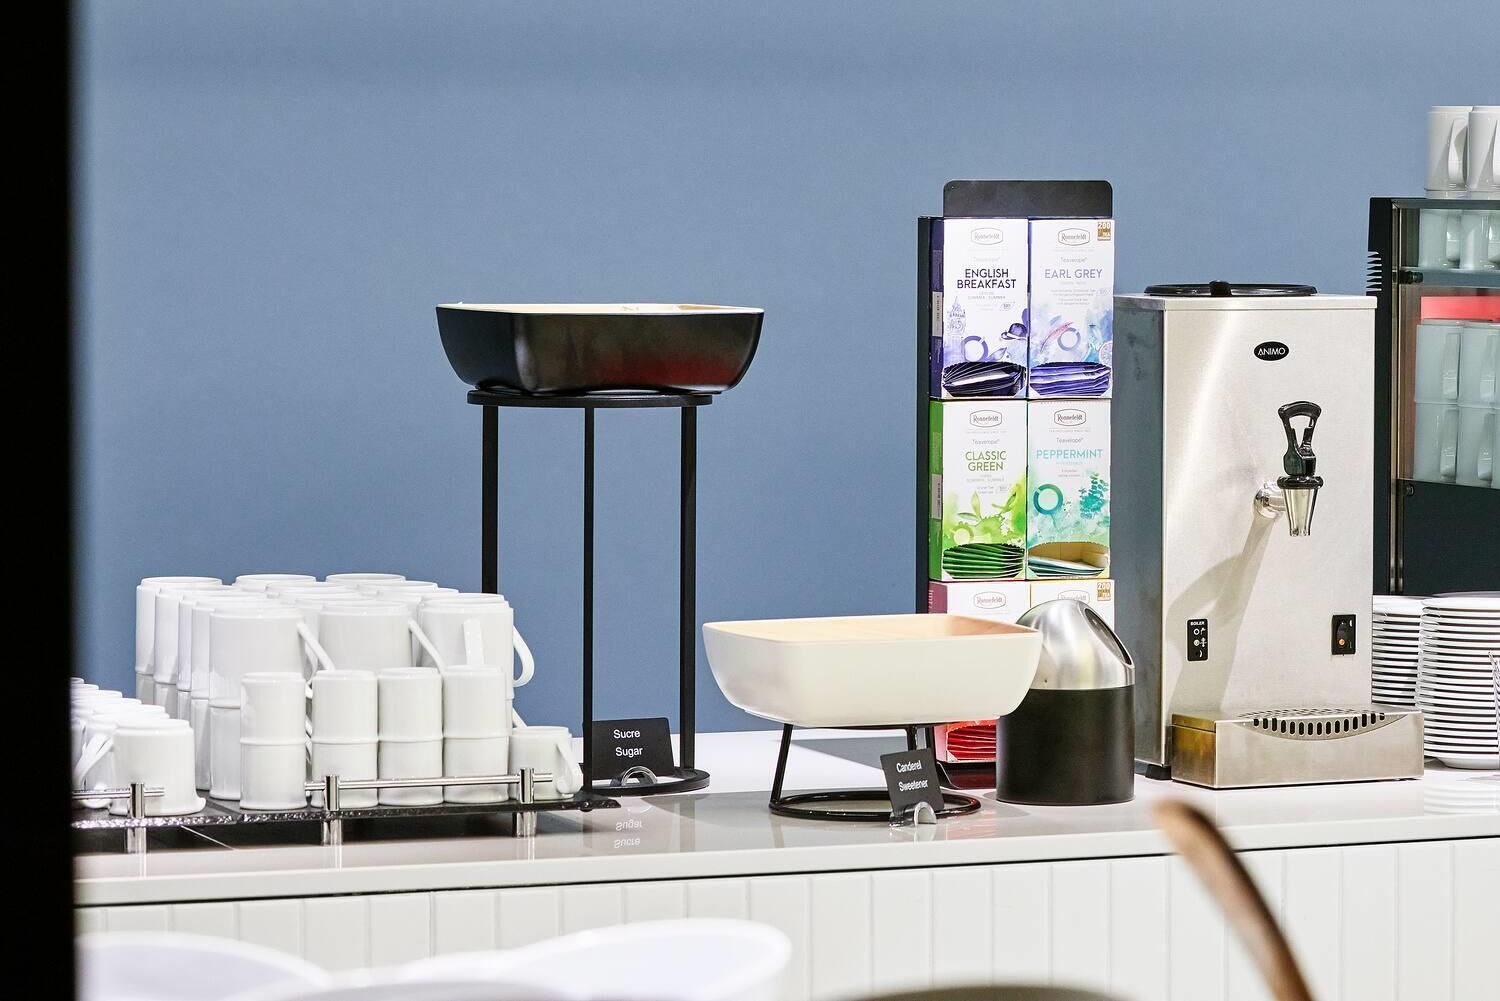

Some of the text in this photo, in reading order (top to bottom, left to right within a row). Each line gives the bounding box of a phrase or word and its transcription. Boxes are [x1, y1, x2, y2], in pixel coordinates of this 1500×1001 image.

[964, 268, 1009, 279] ENGLISH
[1044, 268, 1103, 279] EARL GREY
[956, 278, 1017, 289] BREAKFAST
[1257, 347, 1286, 356] ANIMO
[973, 414, 999, 423] Ronnefeldt
[1057, 413, 1083, 422] Ronnefeldt
[965, 450, 1007, 461] CLASSIC
[1036, 448, 1103, 460] PEPPERMINT
[967, 461, 1004, 472] GREEN
[613, 729, 641, 739] Sucre
[615, 746, 643, 758] Sugar
[898, 779, 929, 792] Sweetener
